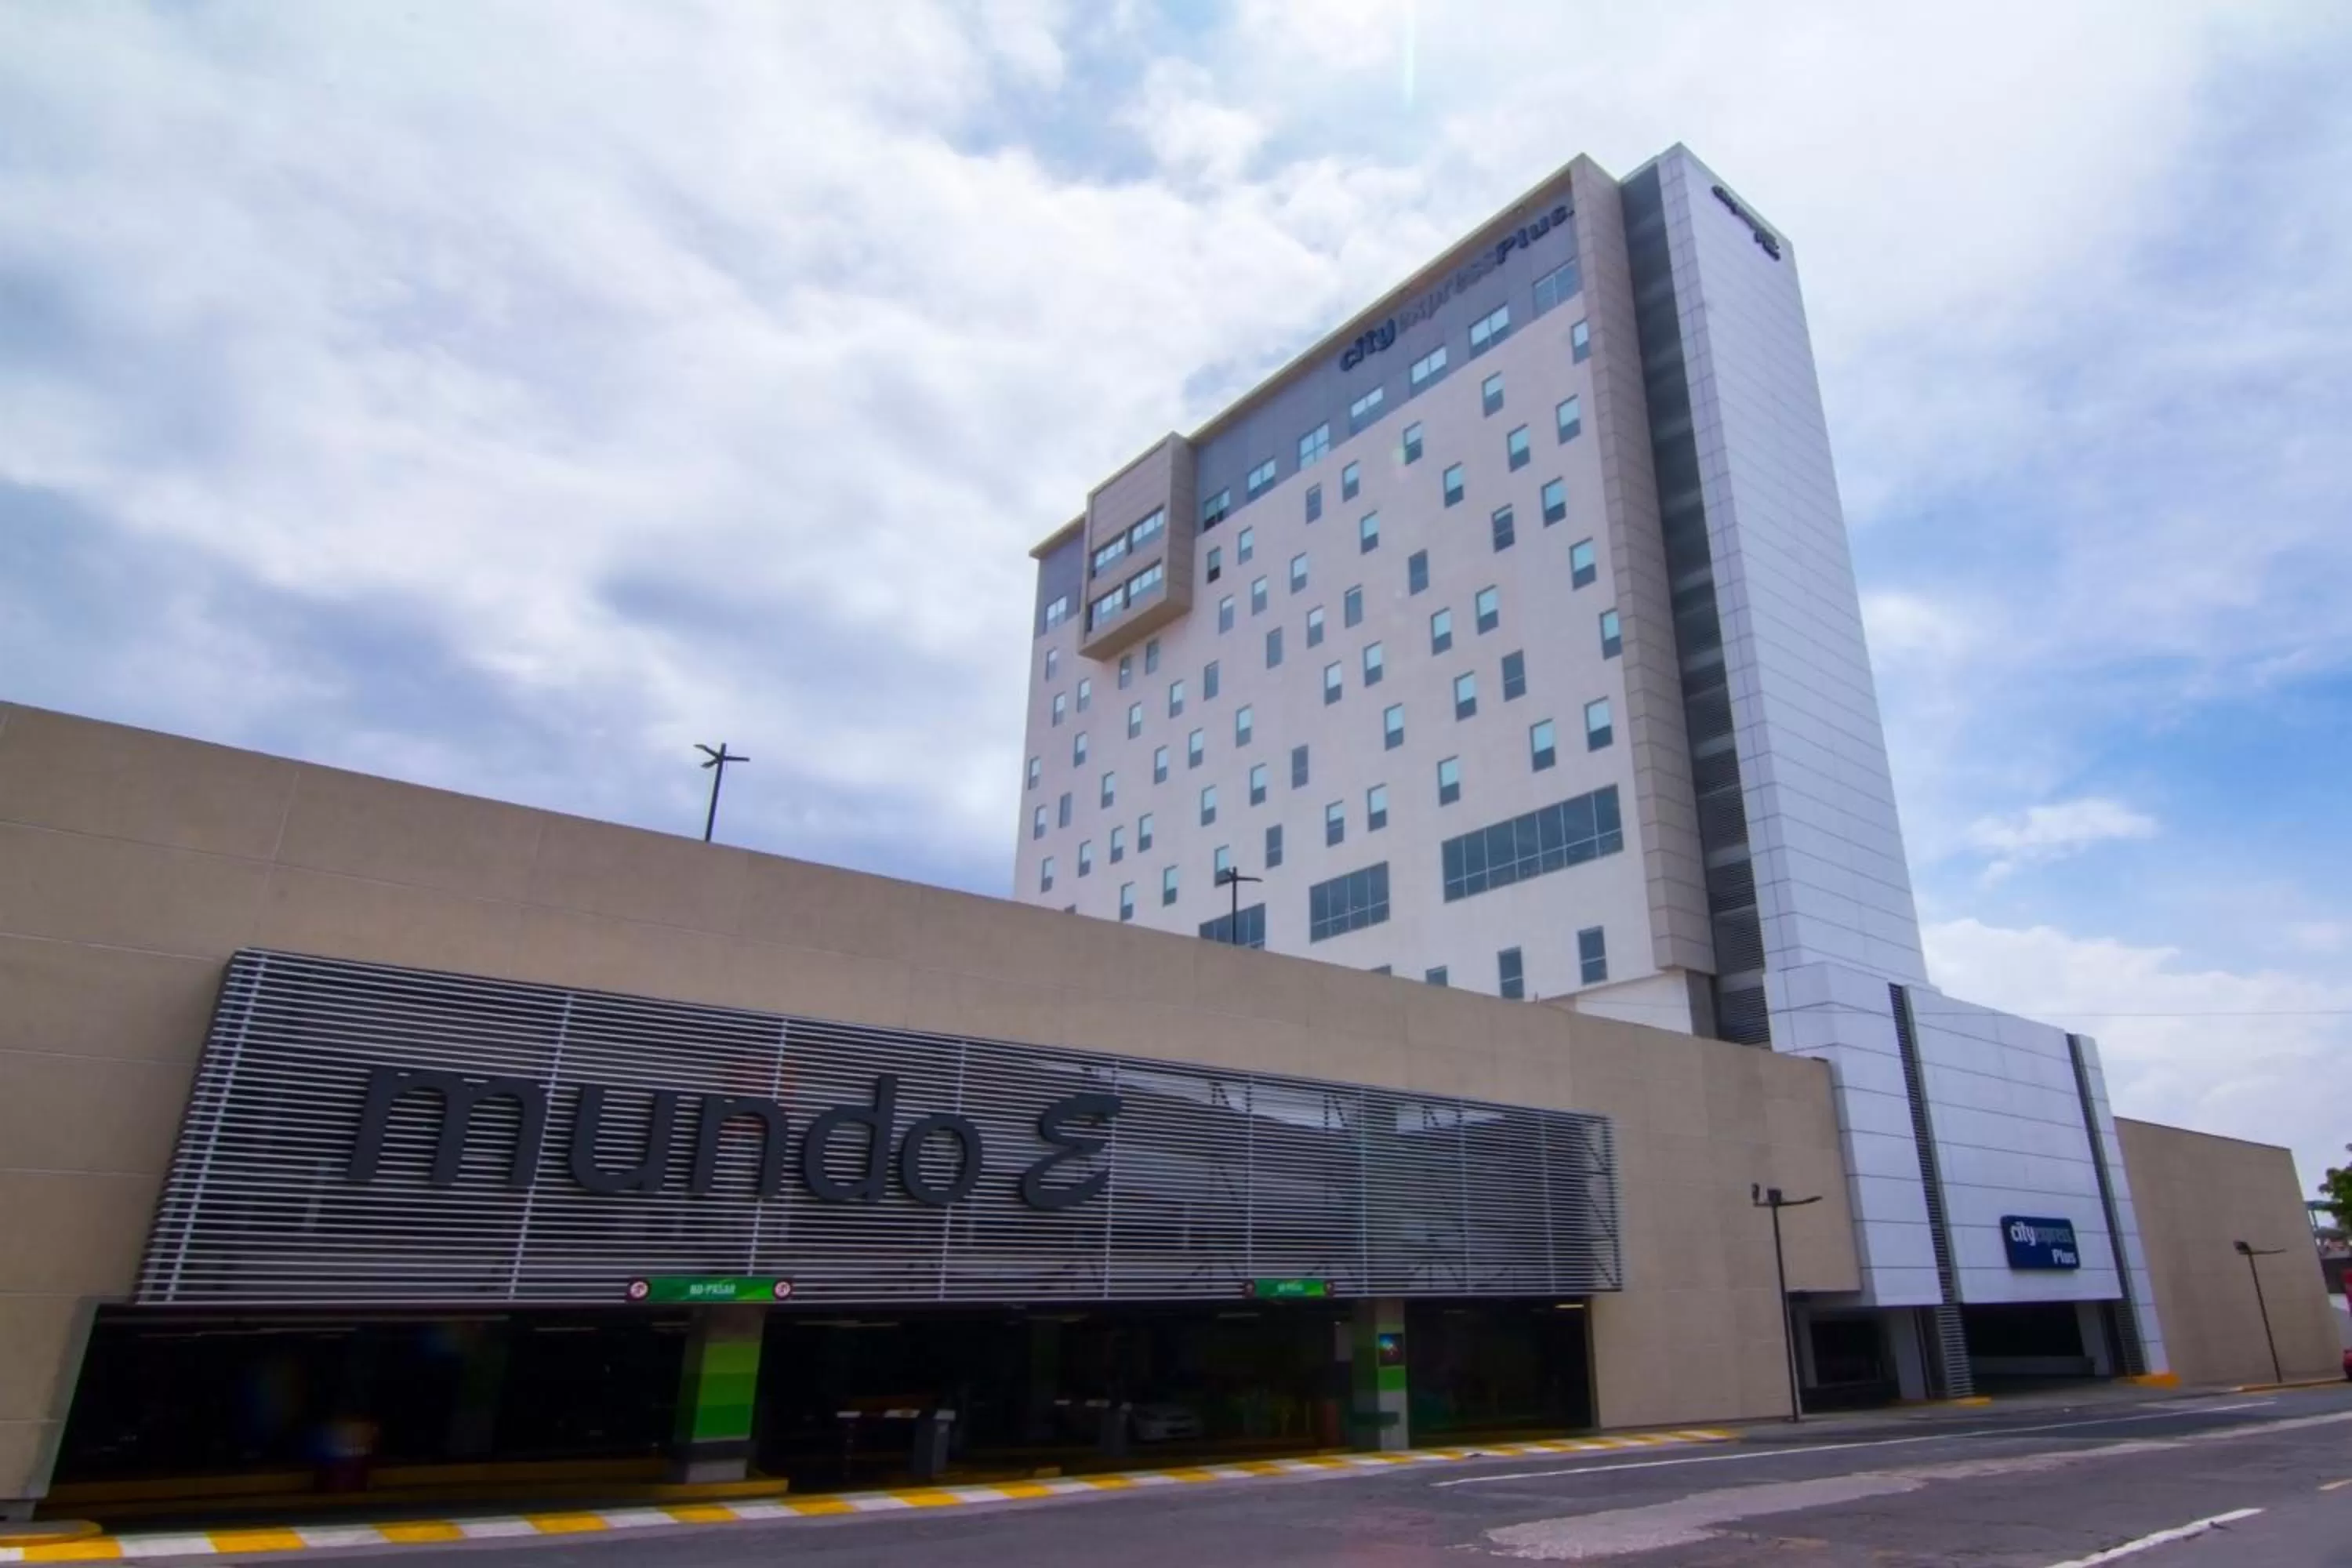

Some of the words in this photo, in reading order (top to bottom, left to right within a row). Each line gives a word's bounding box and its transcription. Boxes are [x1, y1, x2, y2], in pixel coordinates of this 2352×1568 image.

[1340, 318, 1396, 372] city
[346, 1068, 982, 1206] mundo
[2009, 1221, 2036, 1247] city
